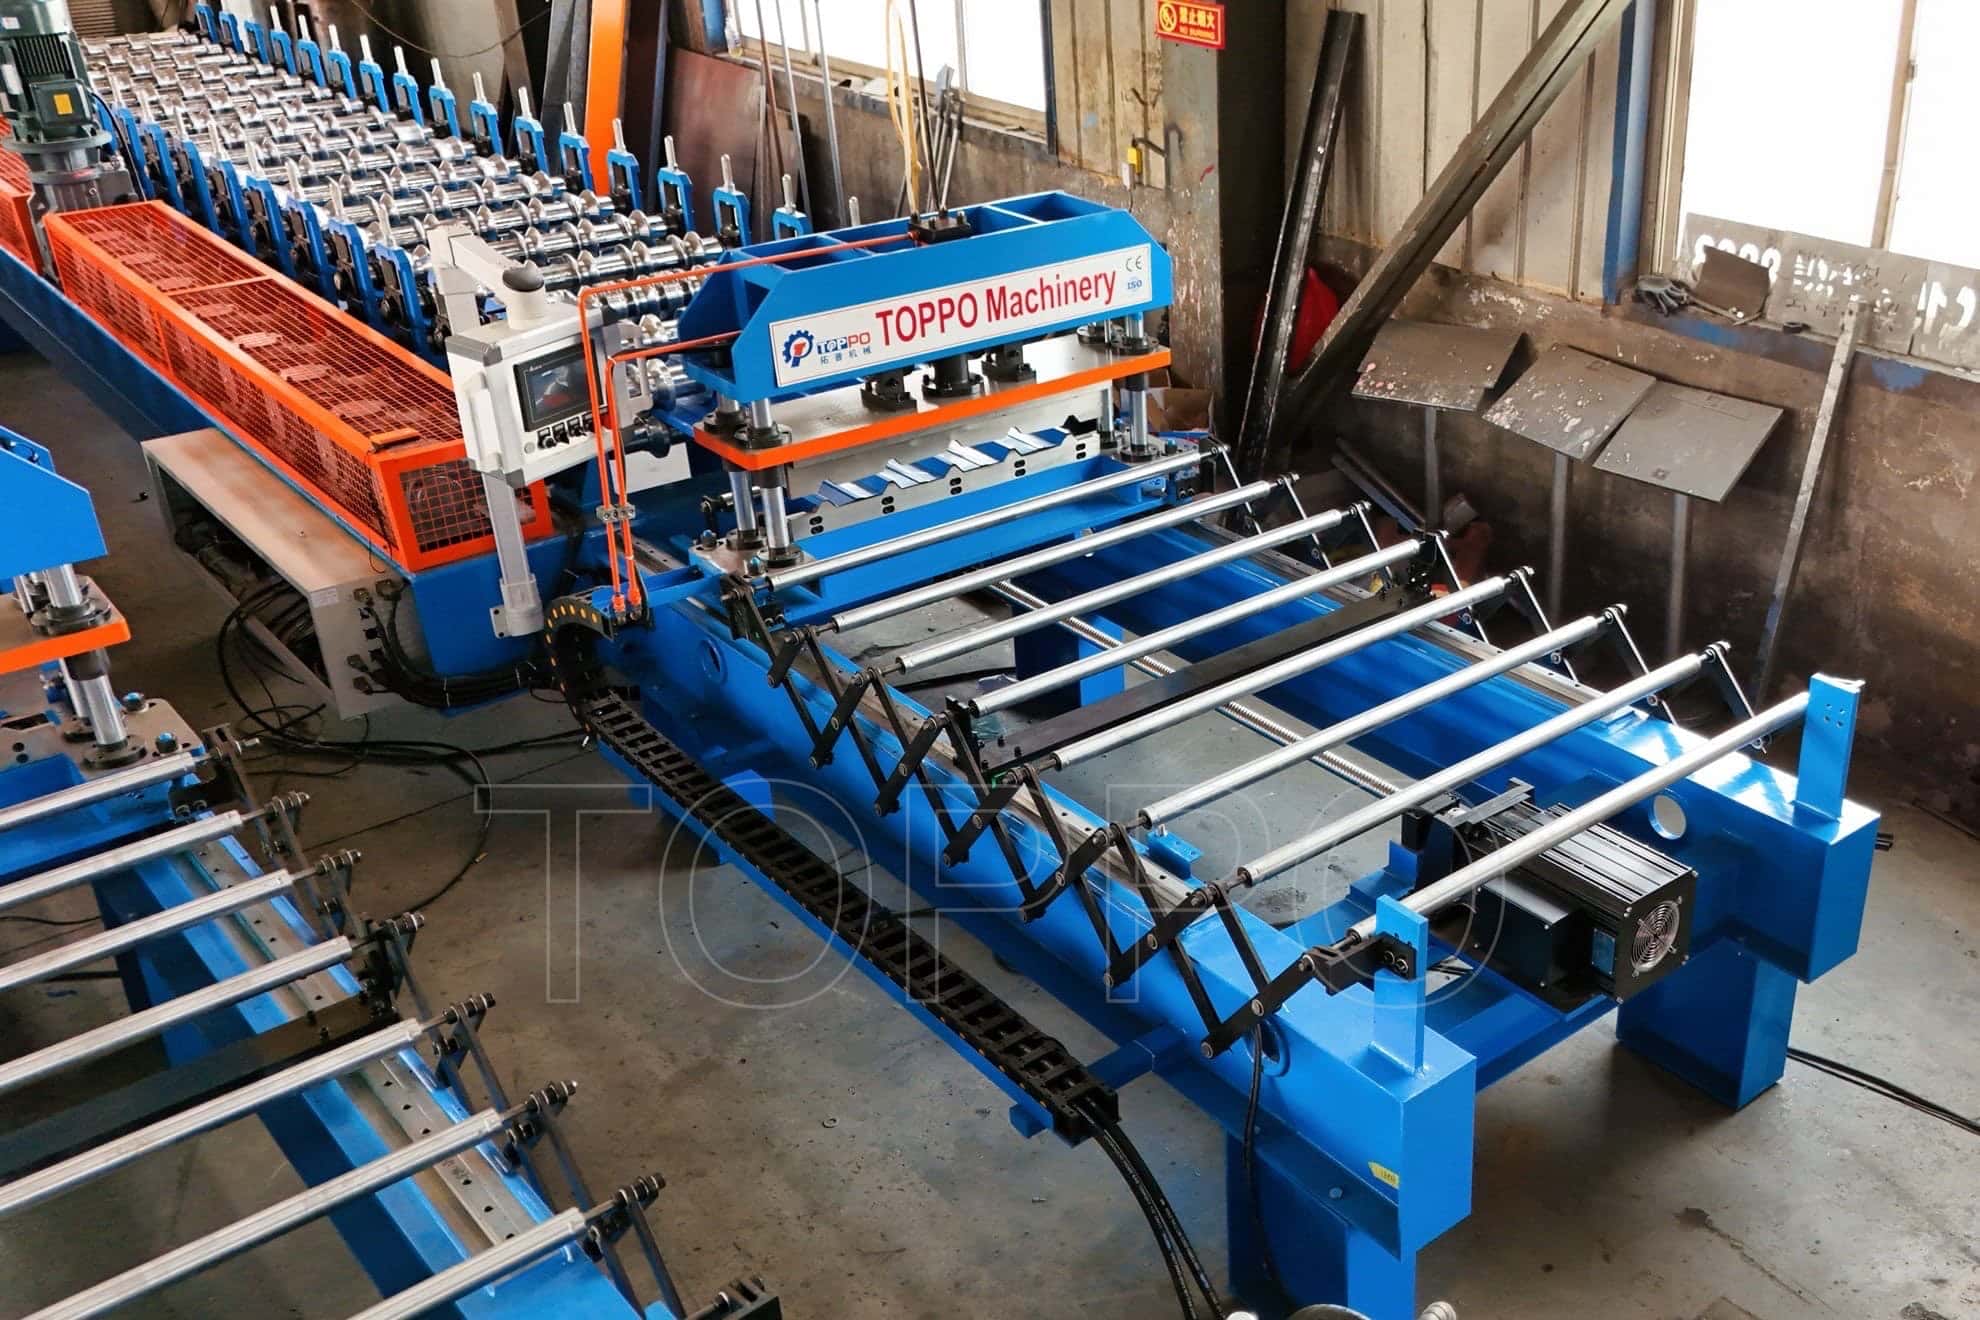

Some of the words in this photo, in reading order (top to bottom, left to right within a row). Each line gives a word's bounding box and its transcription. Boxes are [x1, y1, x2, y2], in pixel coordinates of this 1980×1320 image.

[1126, 255, 1143, 272] CE
[1127, 279, 1143, 290] ISO
[875, 292, 978, 346] TOPPO
[985, 270, 1117, 322] Machinery
[817, 332, 871, 354] TOPPO
